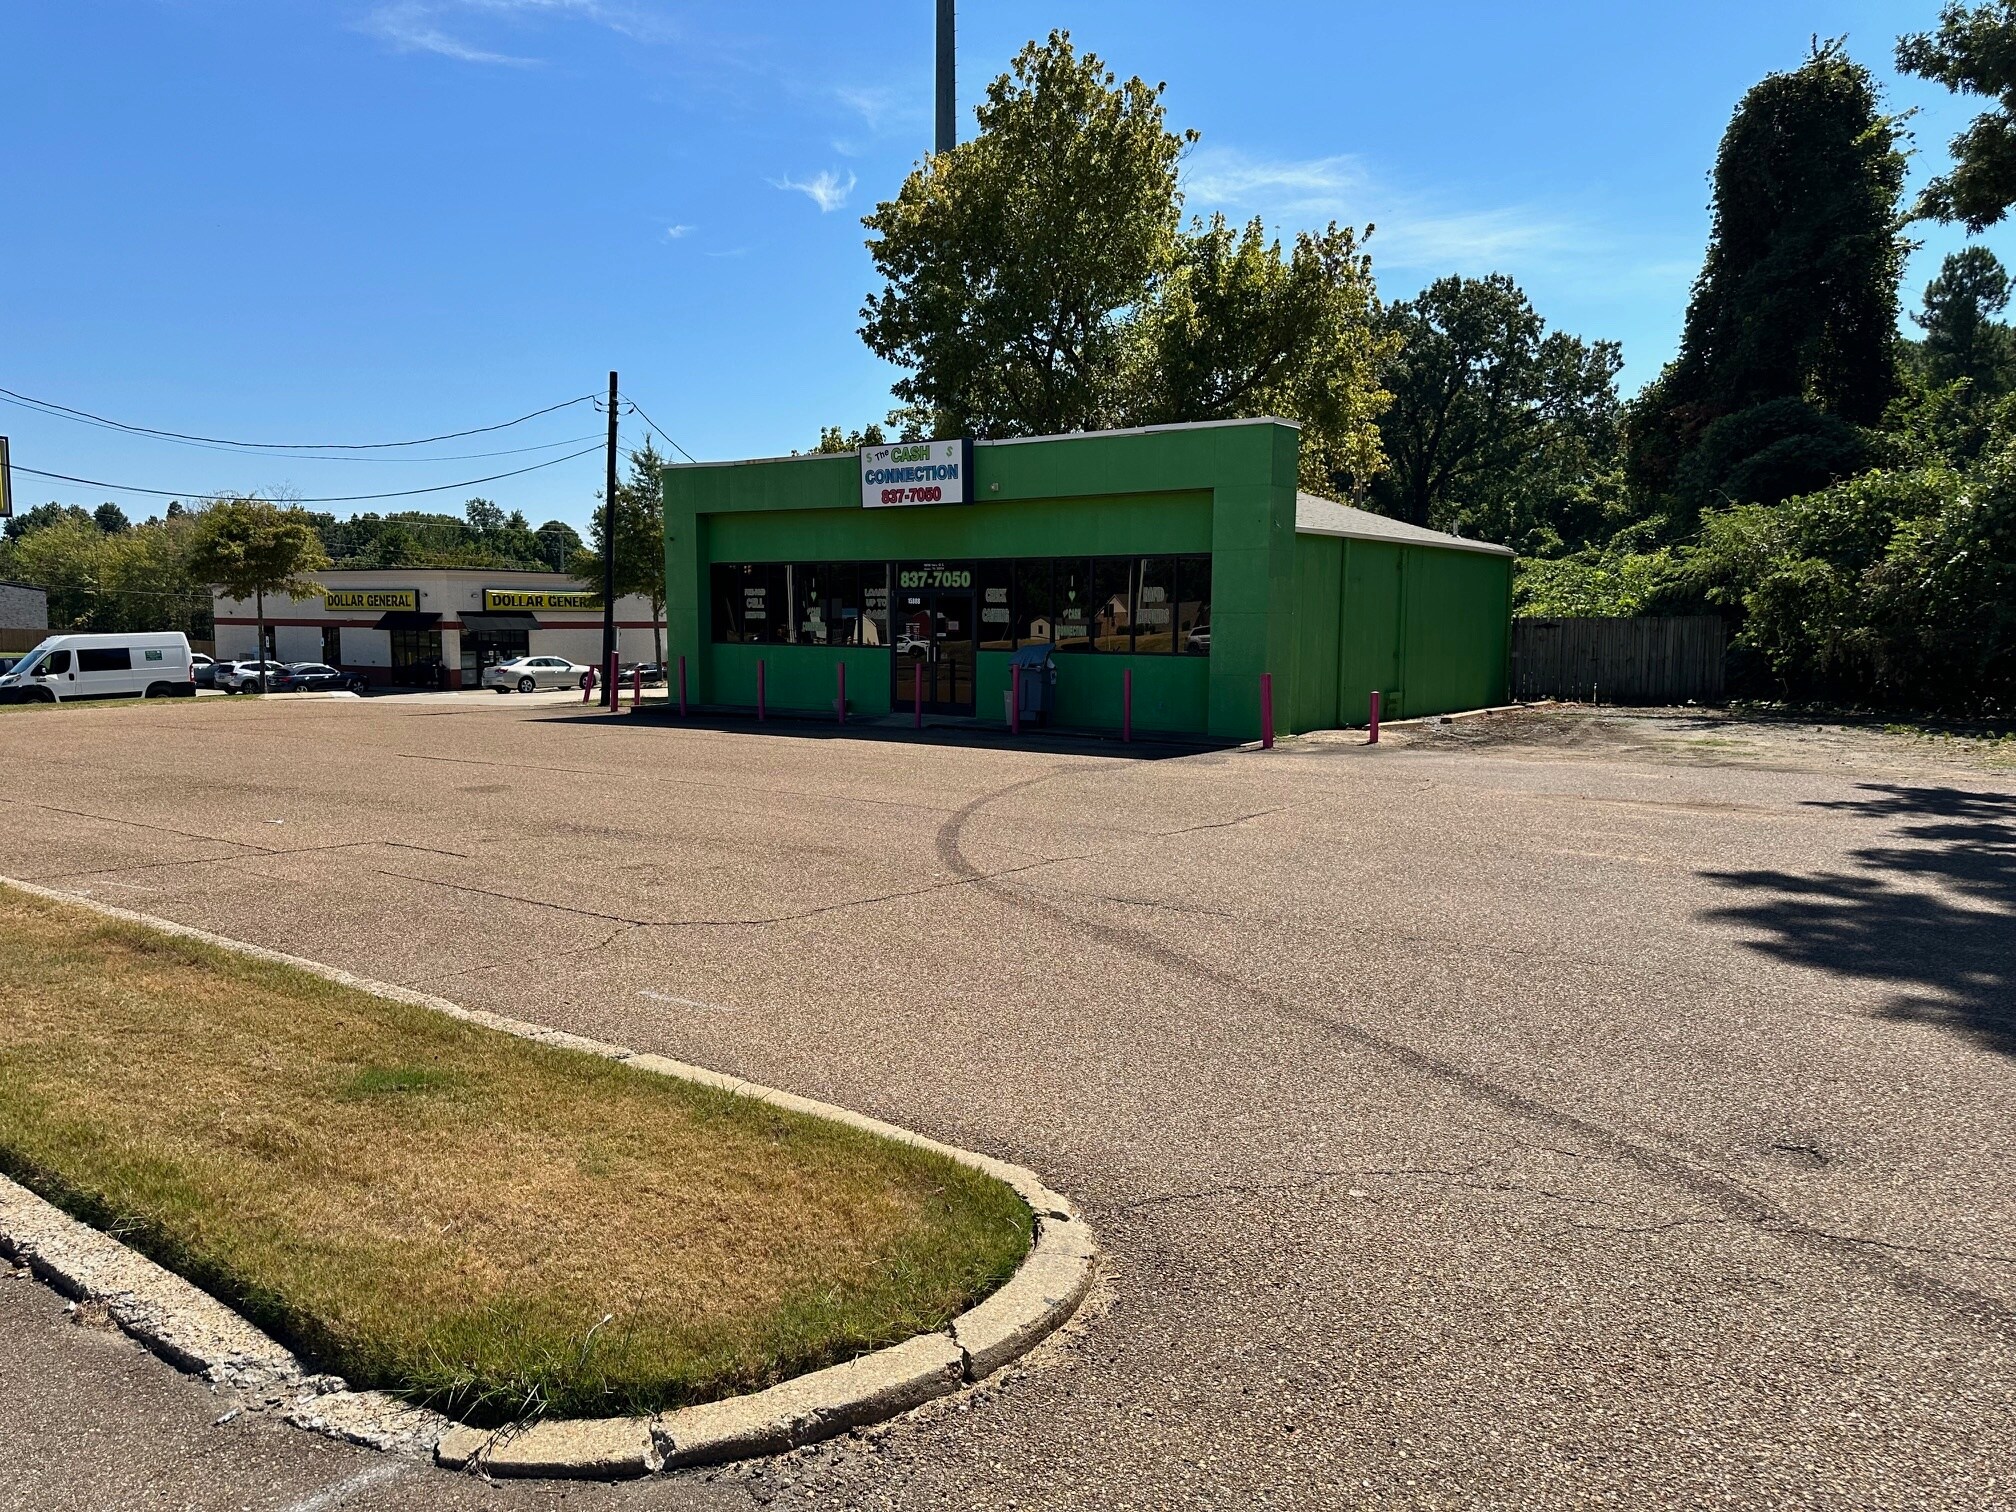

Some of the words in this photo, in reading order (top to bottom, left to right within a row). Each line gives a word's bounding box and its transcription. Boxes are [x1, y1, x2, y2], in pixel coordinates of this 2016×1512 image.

[875, 449, 889, 461] The
[891, 445, 930, 463] CASH
[865, 464, 958, 485] CONNECTION
[881, 486, 942, 504] 837-7050
[900, 570, 971, 588] 837-7050
[327, 595, 364, 607] DOLLAR
[366, 595, 411, 607] GENERAL
[492, 595, 544, 607] DOLLAR
[548, 596, 602, 608] GENER
[866, 598, 876, 607] UP
[877, 598, 887, 607] TO
